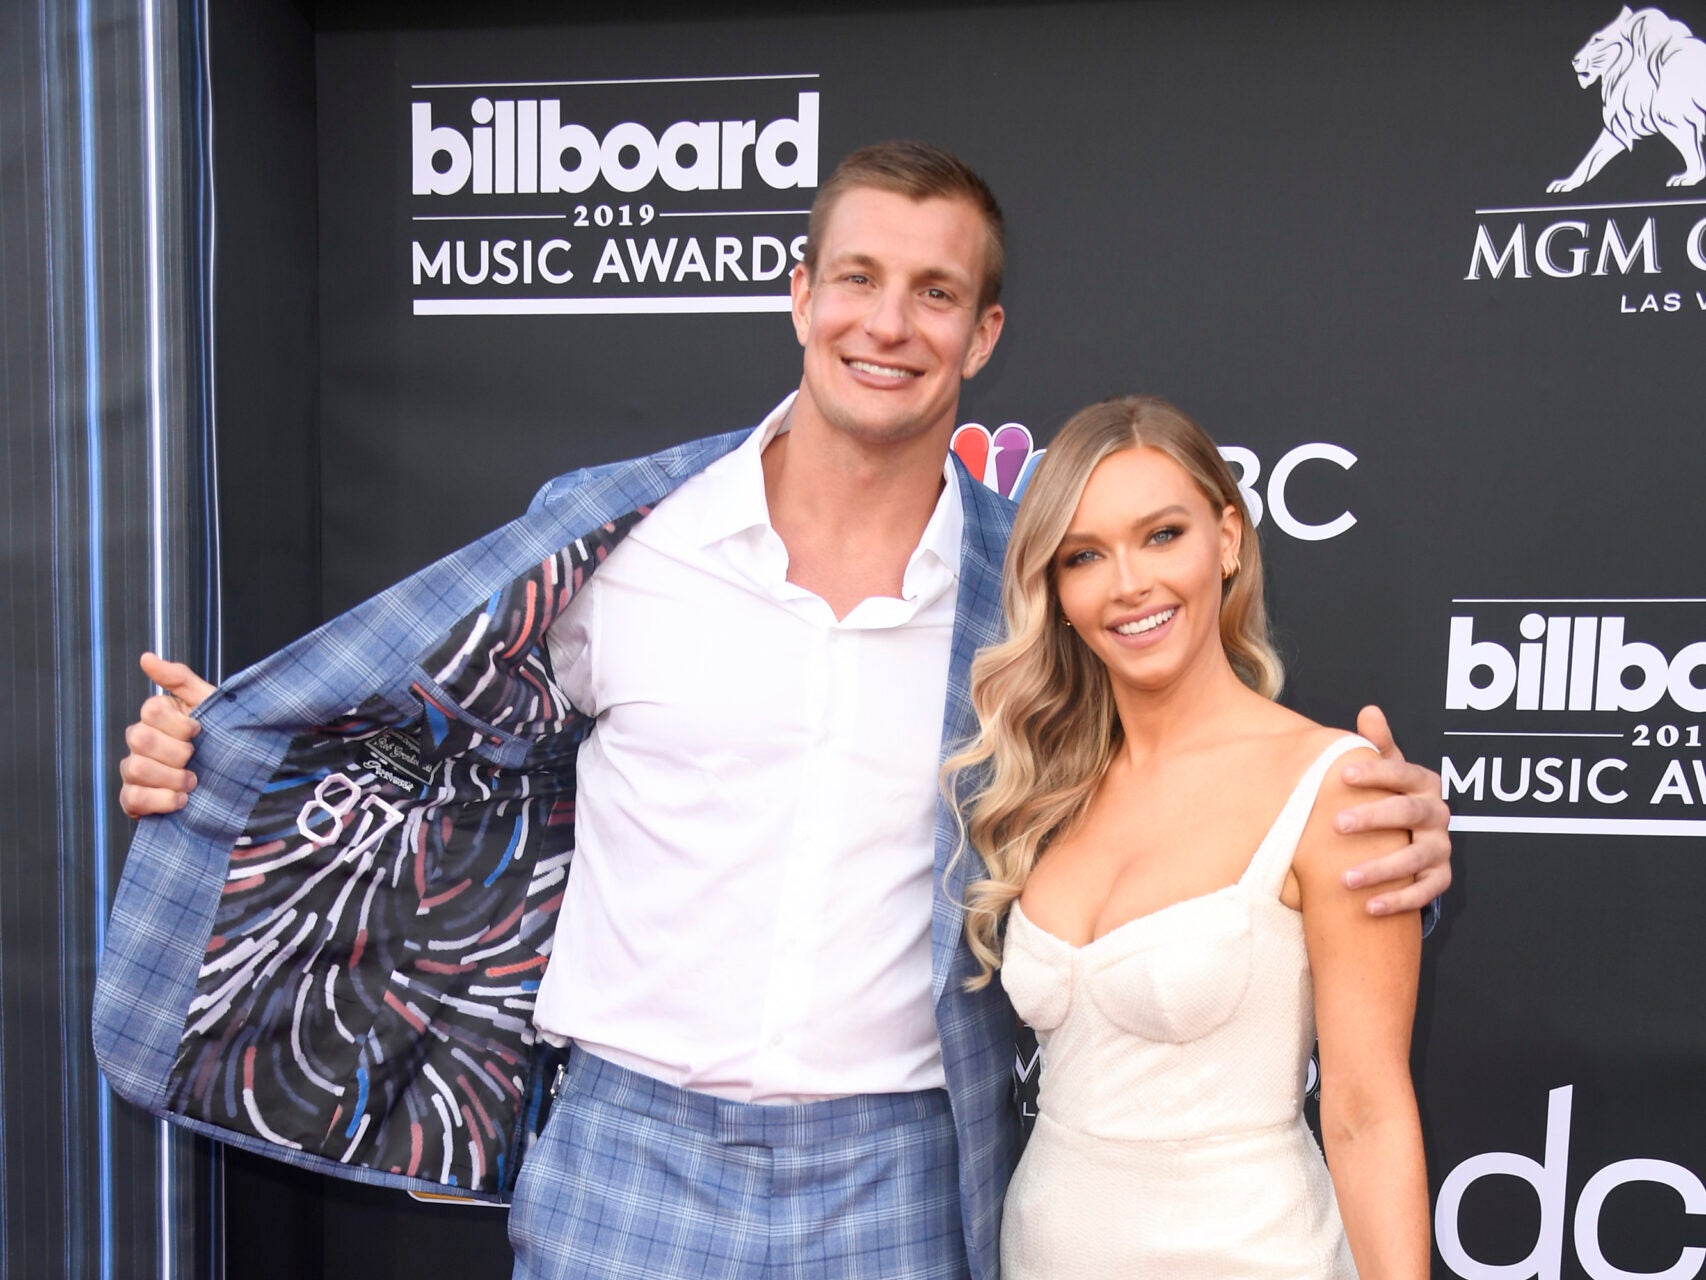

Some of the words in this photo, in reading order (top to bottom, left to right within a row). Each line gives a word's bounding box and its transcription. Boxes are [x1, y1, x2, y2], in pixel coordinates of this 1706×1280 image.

[411, 91, 820, 196] billboard
[572, 203, 655, 227] 2019
[412, 239, 574, 285] MUSIC
[1463, 217, 1662, 281] MGM
[1620, 292, 1682, 313] LAS
[1632, 724, 1702, 748] 201
[1441, 756, 1629, 804] MUSIC
[296, 772, 405, 863] 87
